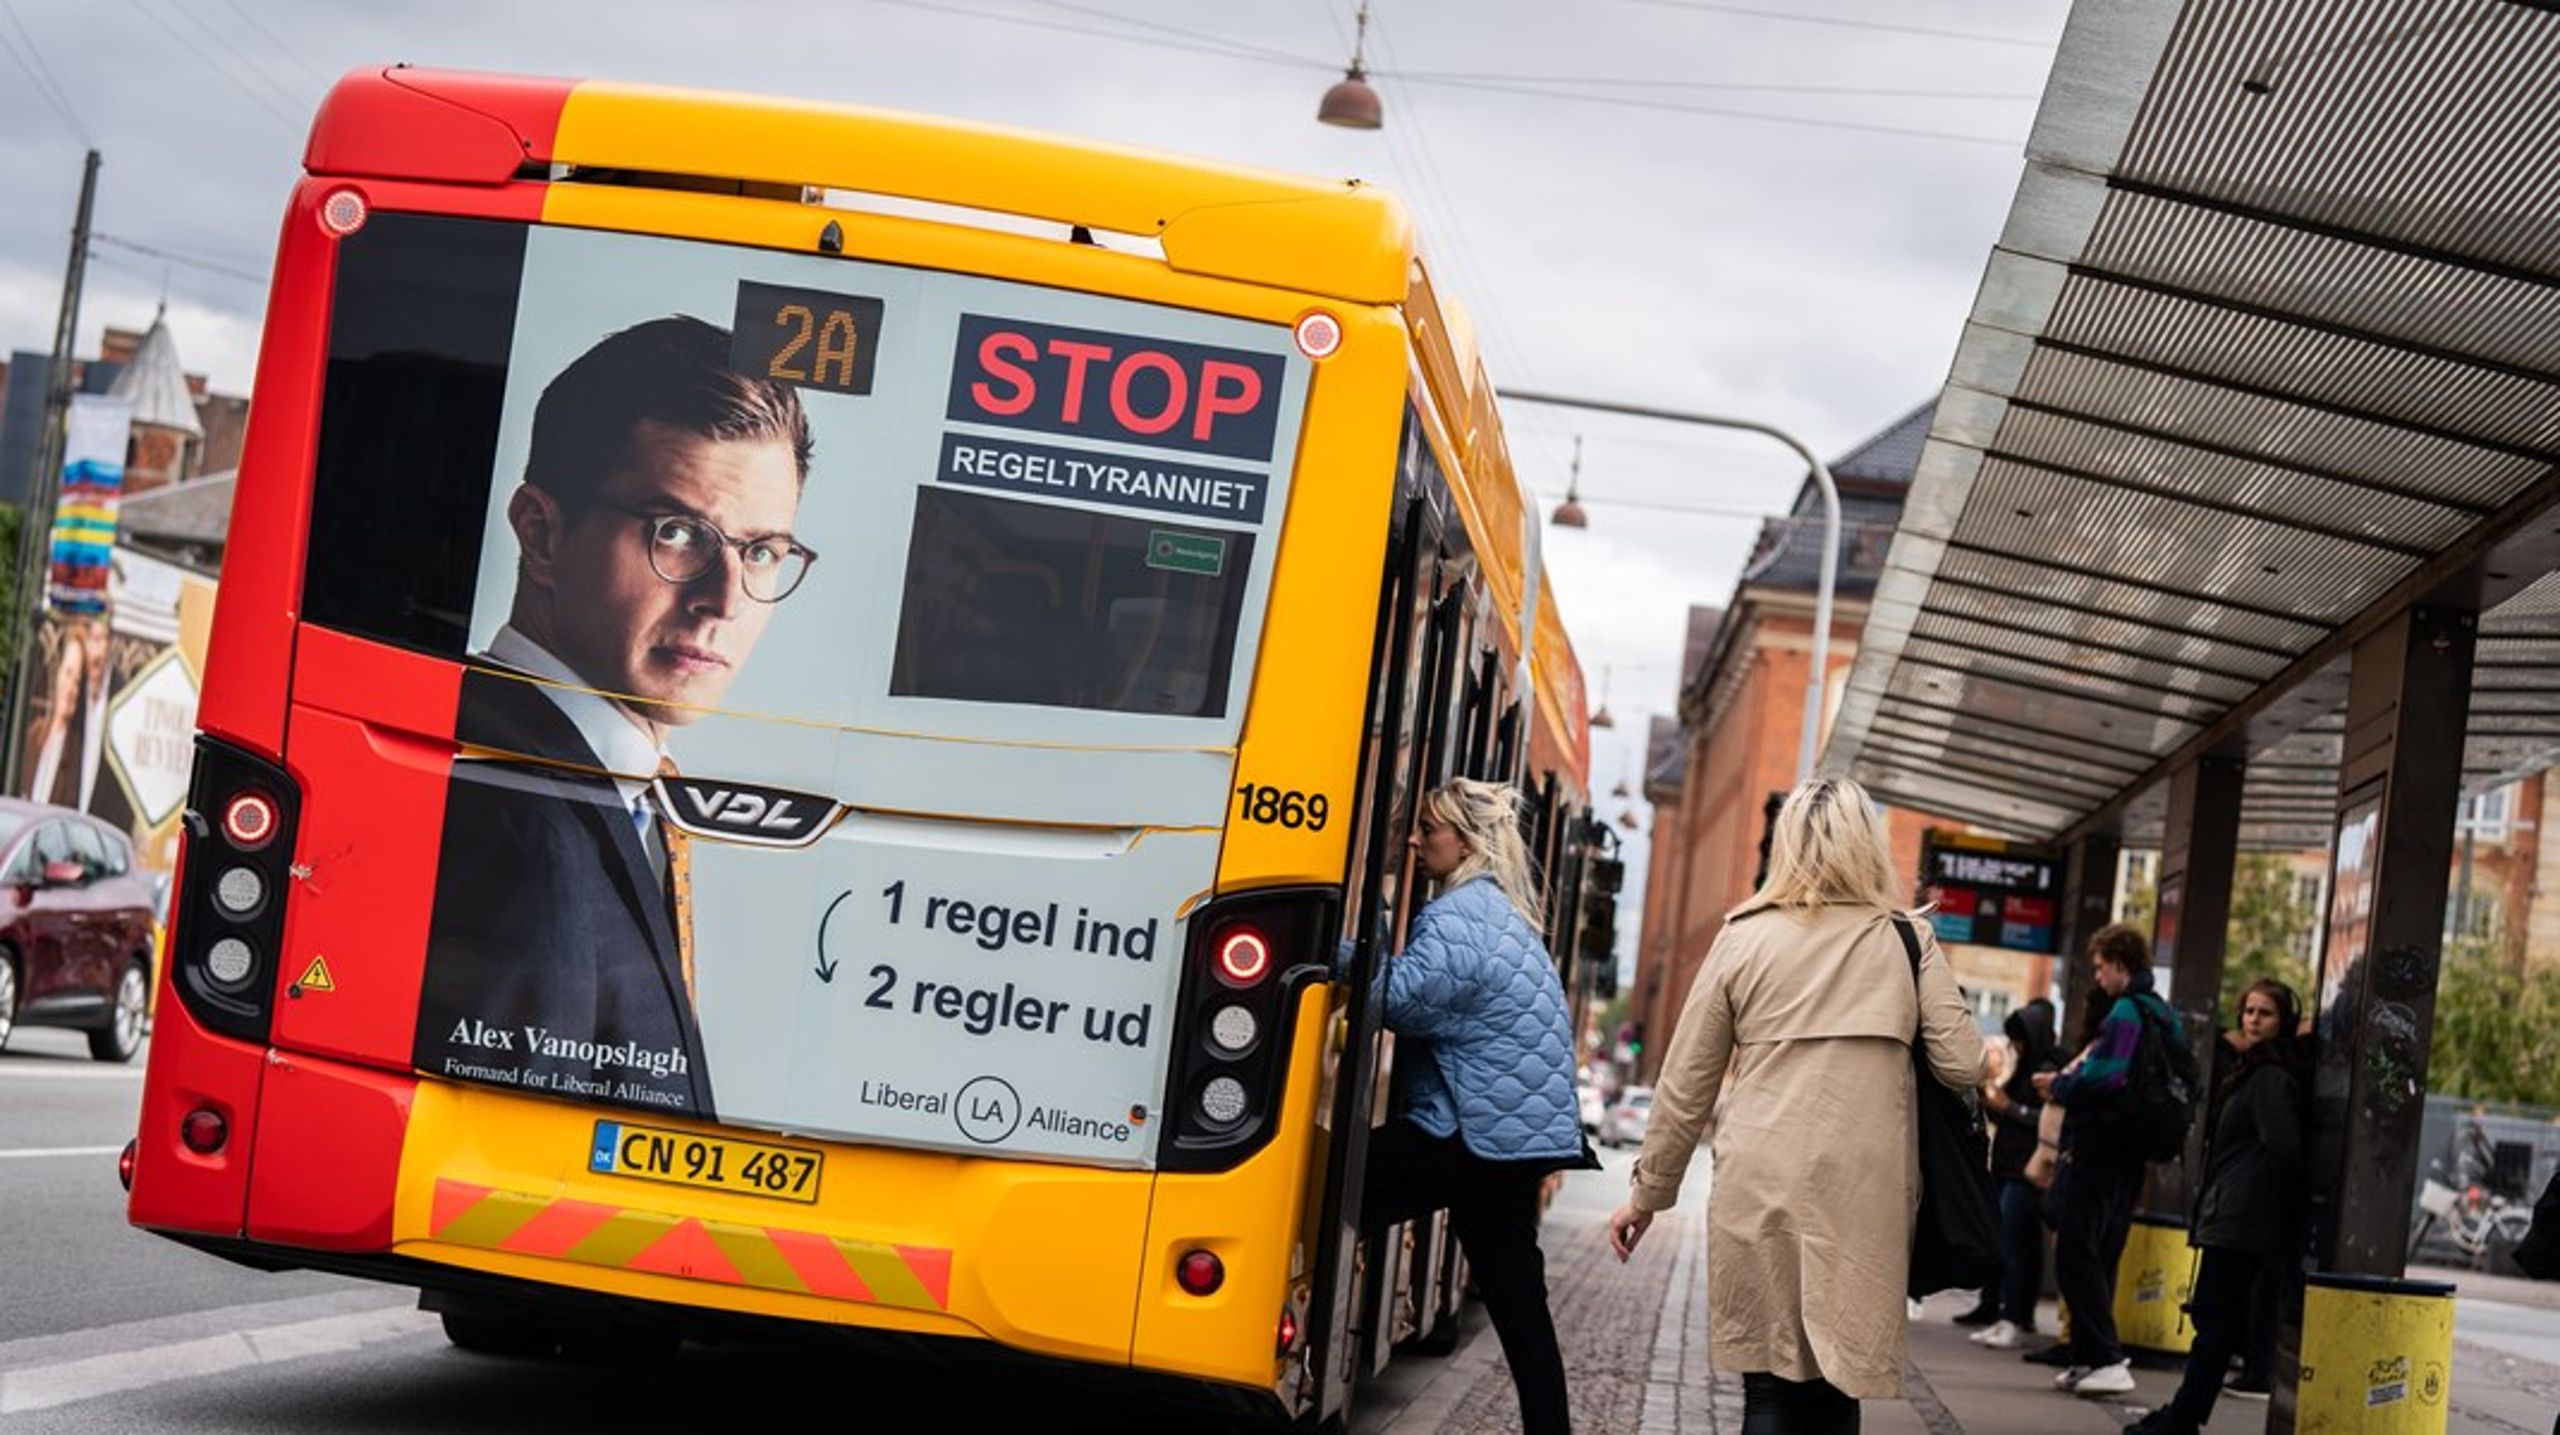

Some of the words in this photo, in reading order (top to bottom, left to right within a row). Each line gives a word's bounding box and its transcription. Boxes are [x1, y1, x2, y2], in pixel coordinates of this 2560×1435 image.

[769, 305, 857, 386] 2A
[971, 332, 1262, 441] STOP
[952, 446, 1255, 510] REGELTYRANNIET
[684, 786, 802, 830] VDL
[1236, 782, 1329, 832] 1869
[883, 880, 905, 924] 1
[925, 896, 1058, 950] regel
[1073, 907, 1158, 962] ind
[864, 964, 898, 1010] 2
[912, 979, 1070, 1035] regler
[1083, 1004, 1152, 1048] ud
[448, 1016, 515, 1050] Alex
[524, 1026, 688, 1079] Vanopslagh
[444, 1057, 518, 1084] Formand
[522, 1068, 548, 1087] for
[551, 1073, 611, 1097] Liberal
[614, 1083, 685, 1107] Alliance
[860, 1081, 948, 1115] Liberal
[970, 1097, 1005, 1124] LA
[1026, 1107, 1131, 1142] Alliance
[595, 1148, 611, 1164] DK
[621, 1133, 676, 1174] CN
[684, 1142, 724, 1182] 91
[741, 1151, 816, 1193] 487
